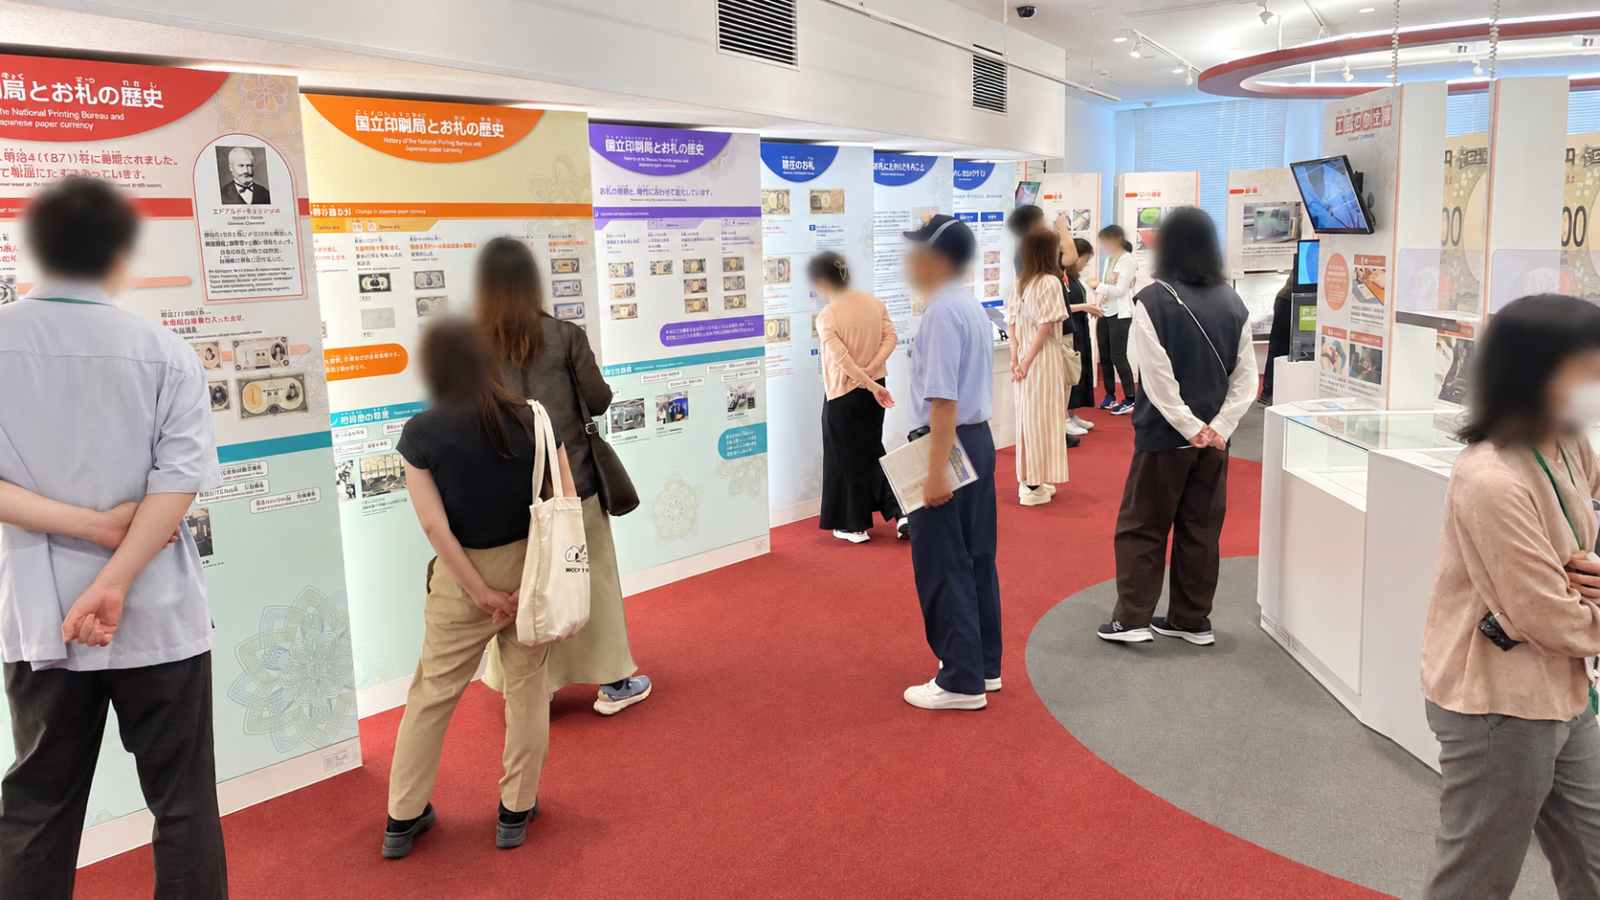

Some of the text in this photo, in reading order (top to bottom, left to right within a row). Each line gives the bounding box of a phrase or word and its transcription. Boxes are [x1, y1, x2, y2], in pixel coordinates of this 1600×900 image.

[0, 79, 164, 109] 局とお札の歴史
[0, 108, 10, 116] he
[48, 109, 80, 120] Printing
[81, 111, 109, 120] Bureau
[110, 113, 125, 121] and
[0, 119, 94, 131] apanese paper currency
[355, 115, 505, 138] 国立印刷局とお札の歴史
